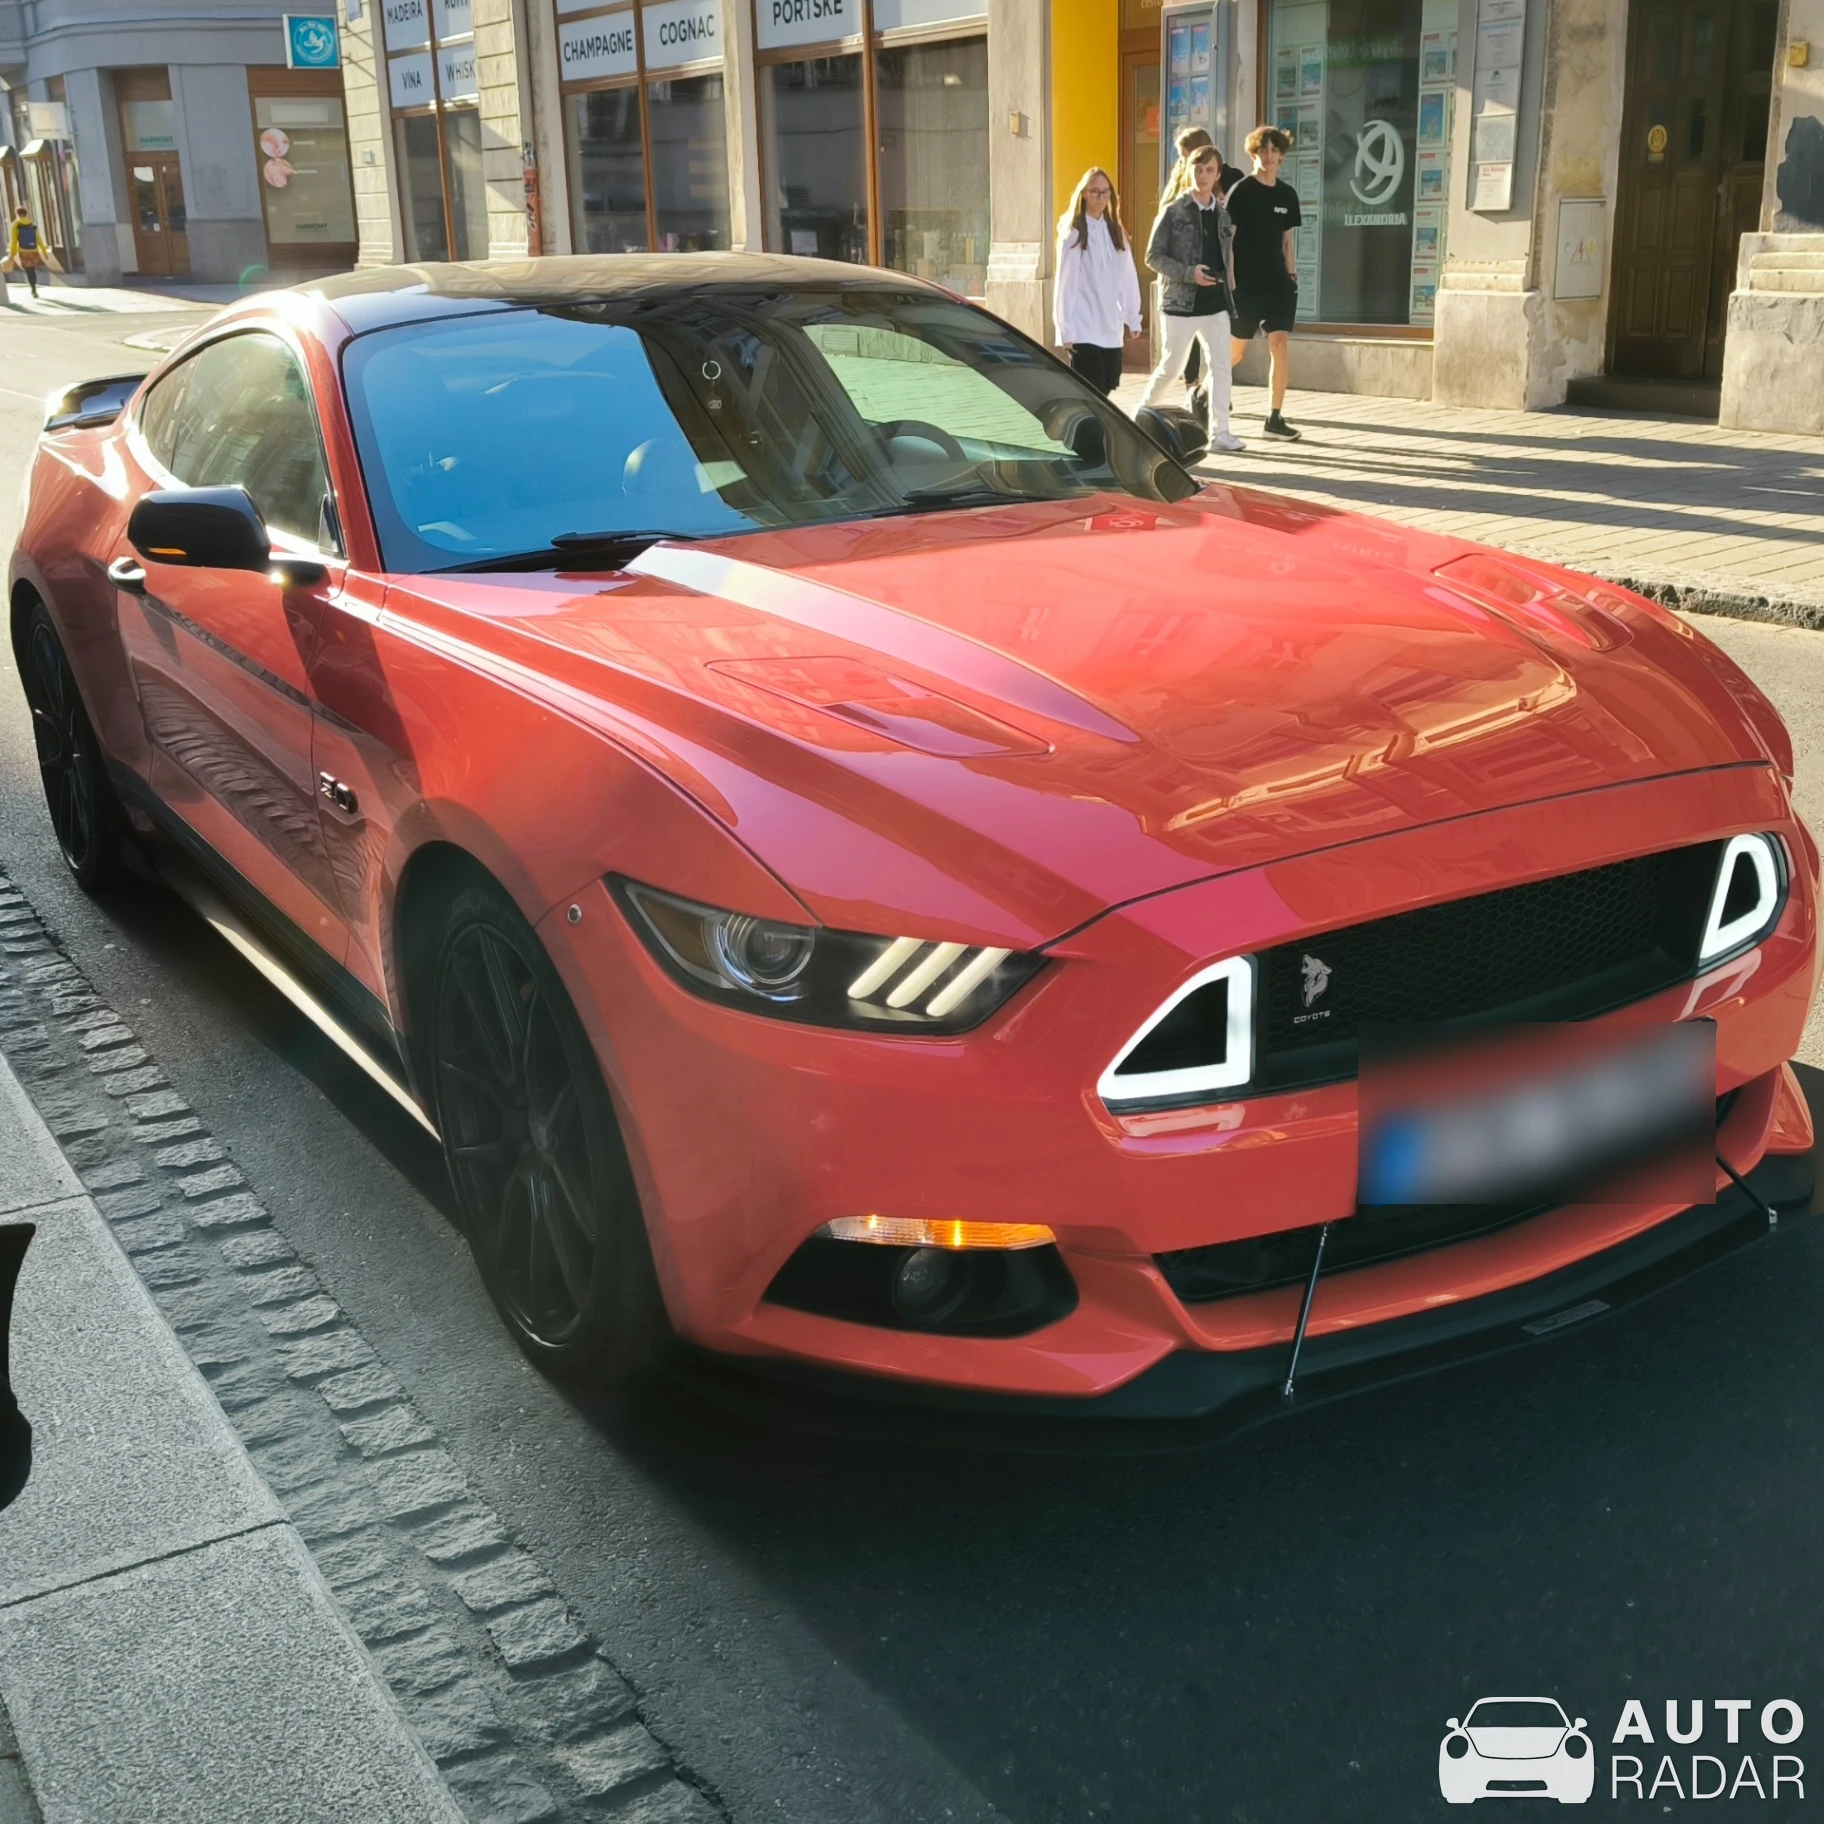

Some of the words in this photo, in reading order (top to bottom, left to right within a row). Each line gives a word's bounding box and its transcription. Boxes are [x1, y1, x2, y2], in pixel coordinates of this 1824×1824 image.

[386, 1, 423, 25] MADEIRA
[659, 14, 715, 46] COGNAC
[563, 29, 633, 62] CHAMPAGNE
[401, 68, 422, 90] VÍNA
[1293, 1010, 1331, 1024] COYOTE
